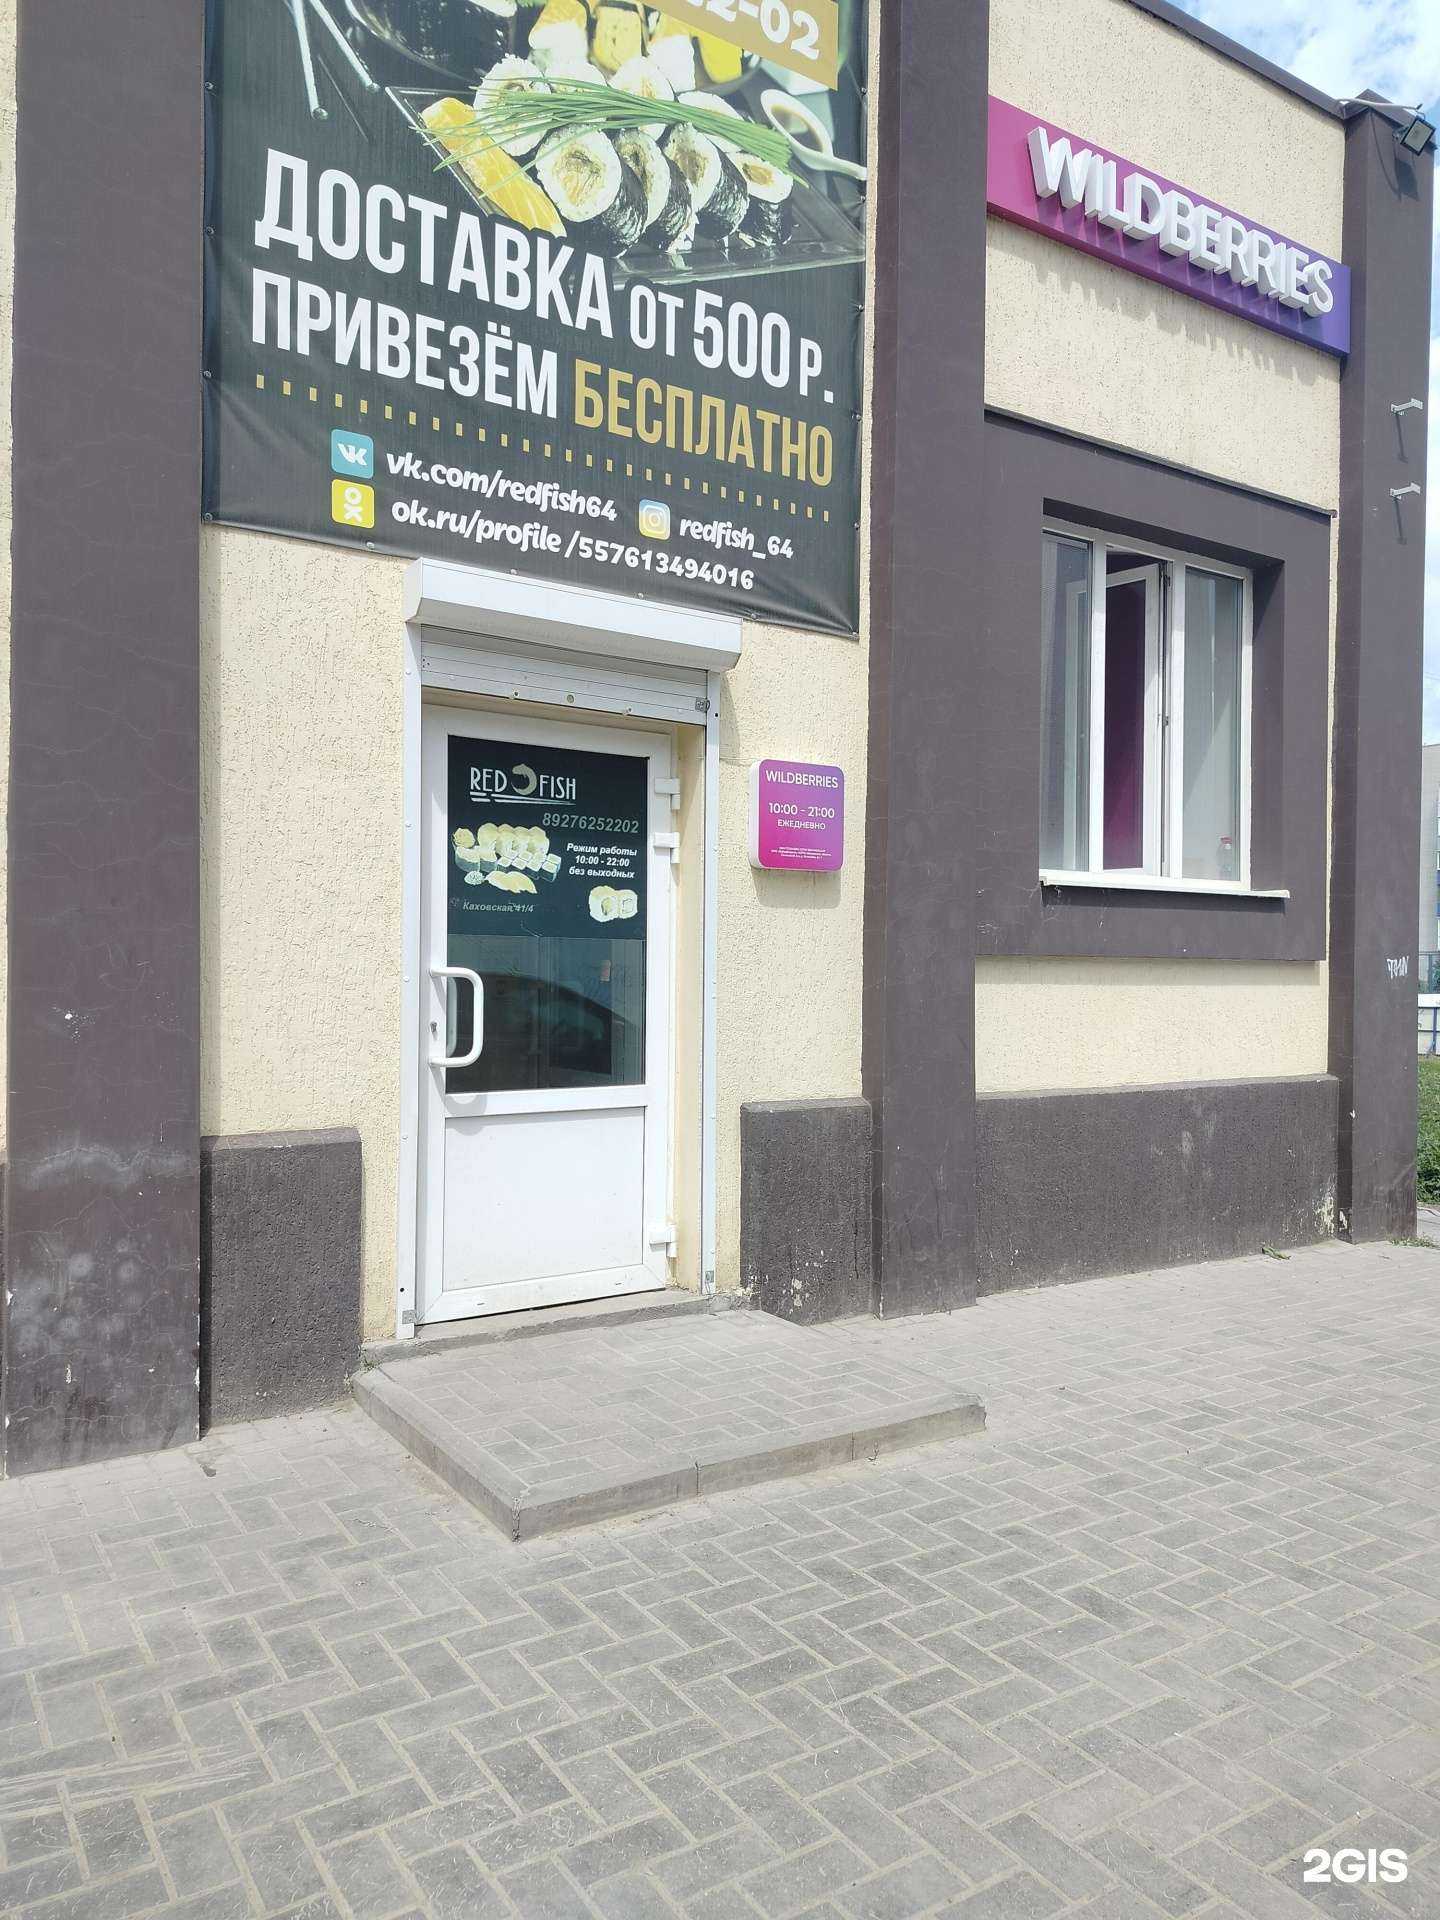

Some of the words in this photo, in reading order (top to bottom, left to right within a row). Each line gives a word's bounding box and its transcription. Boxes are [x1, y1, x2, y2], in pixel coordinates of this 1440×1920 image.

[1027, 126, 1334, 318] WILDBERRIES
[254, 147, 613, 339] ДОСТАВКА
[628, 284, 684, 358] ОТ
[692, 289, 791, 389] 500
[251, 267, 559, 419] ПРИВЕЗЁМ
[573, 358, 833, 488] БЕСПЛАТНО
[386, 452, 618, 522] vk.com/redfish64
[391, 500, 562, 552] ok.ru/profile
[679, 517, 794, 560] redfish_64
[469, 766, 508, 794] RED
[539, 774, 577, 800] FISH
[765, 769, 839, 788] WILDBERRIES
[541, 812, 640, 834] 89276252202
[768, 802, 798, 815] 10:00
[808, 806, 835, 819] 21:00
[777, 818, 826, 830] ЕЖЕДНЕВНО
[566, 842, 598, 854] Режим
[599, 845, 638, 856] работы
[575, 854, 599, 865] 10:00
[606, 857, 630, 867] 22:00
[568, 866, 586, 876] без
[586, 868, 635, 879] выходных
